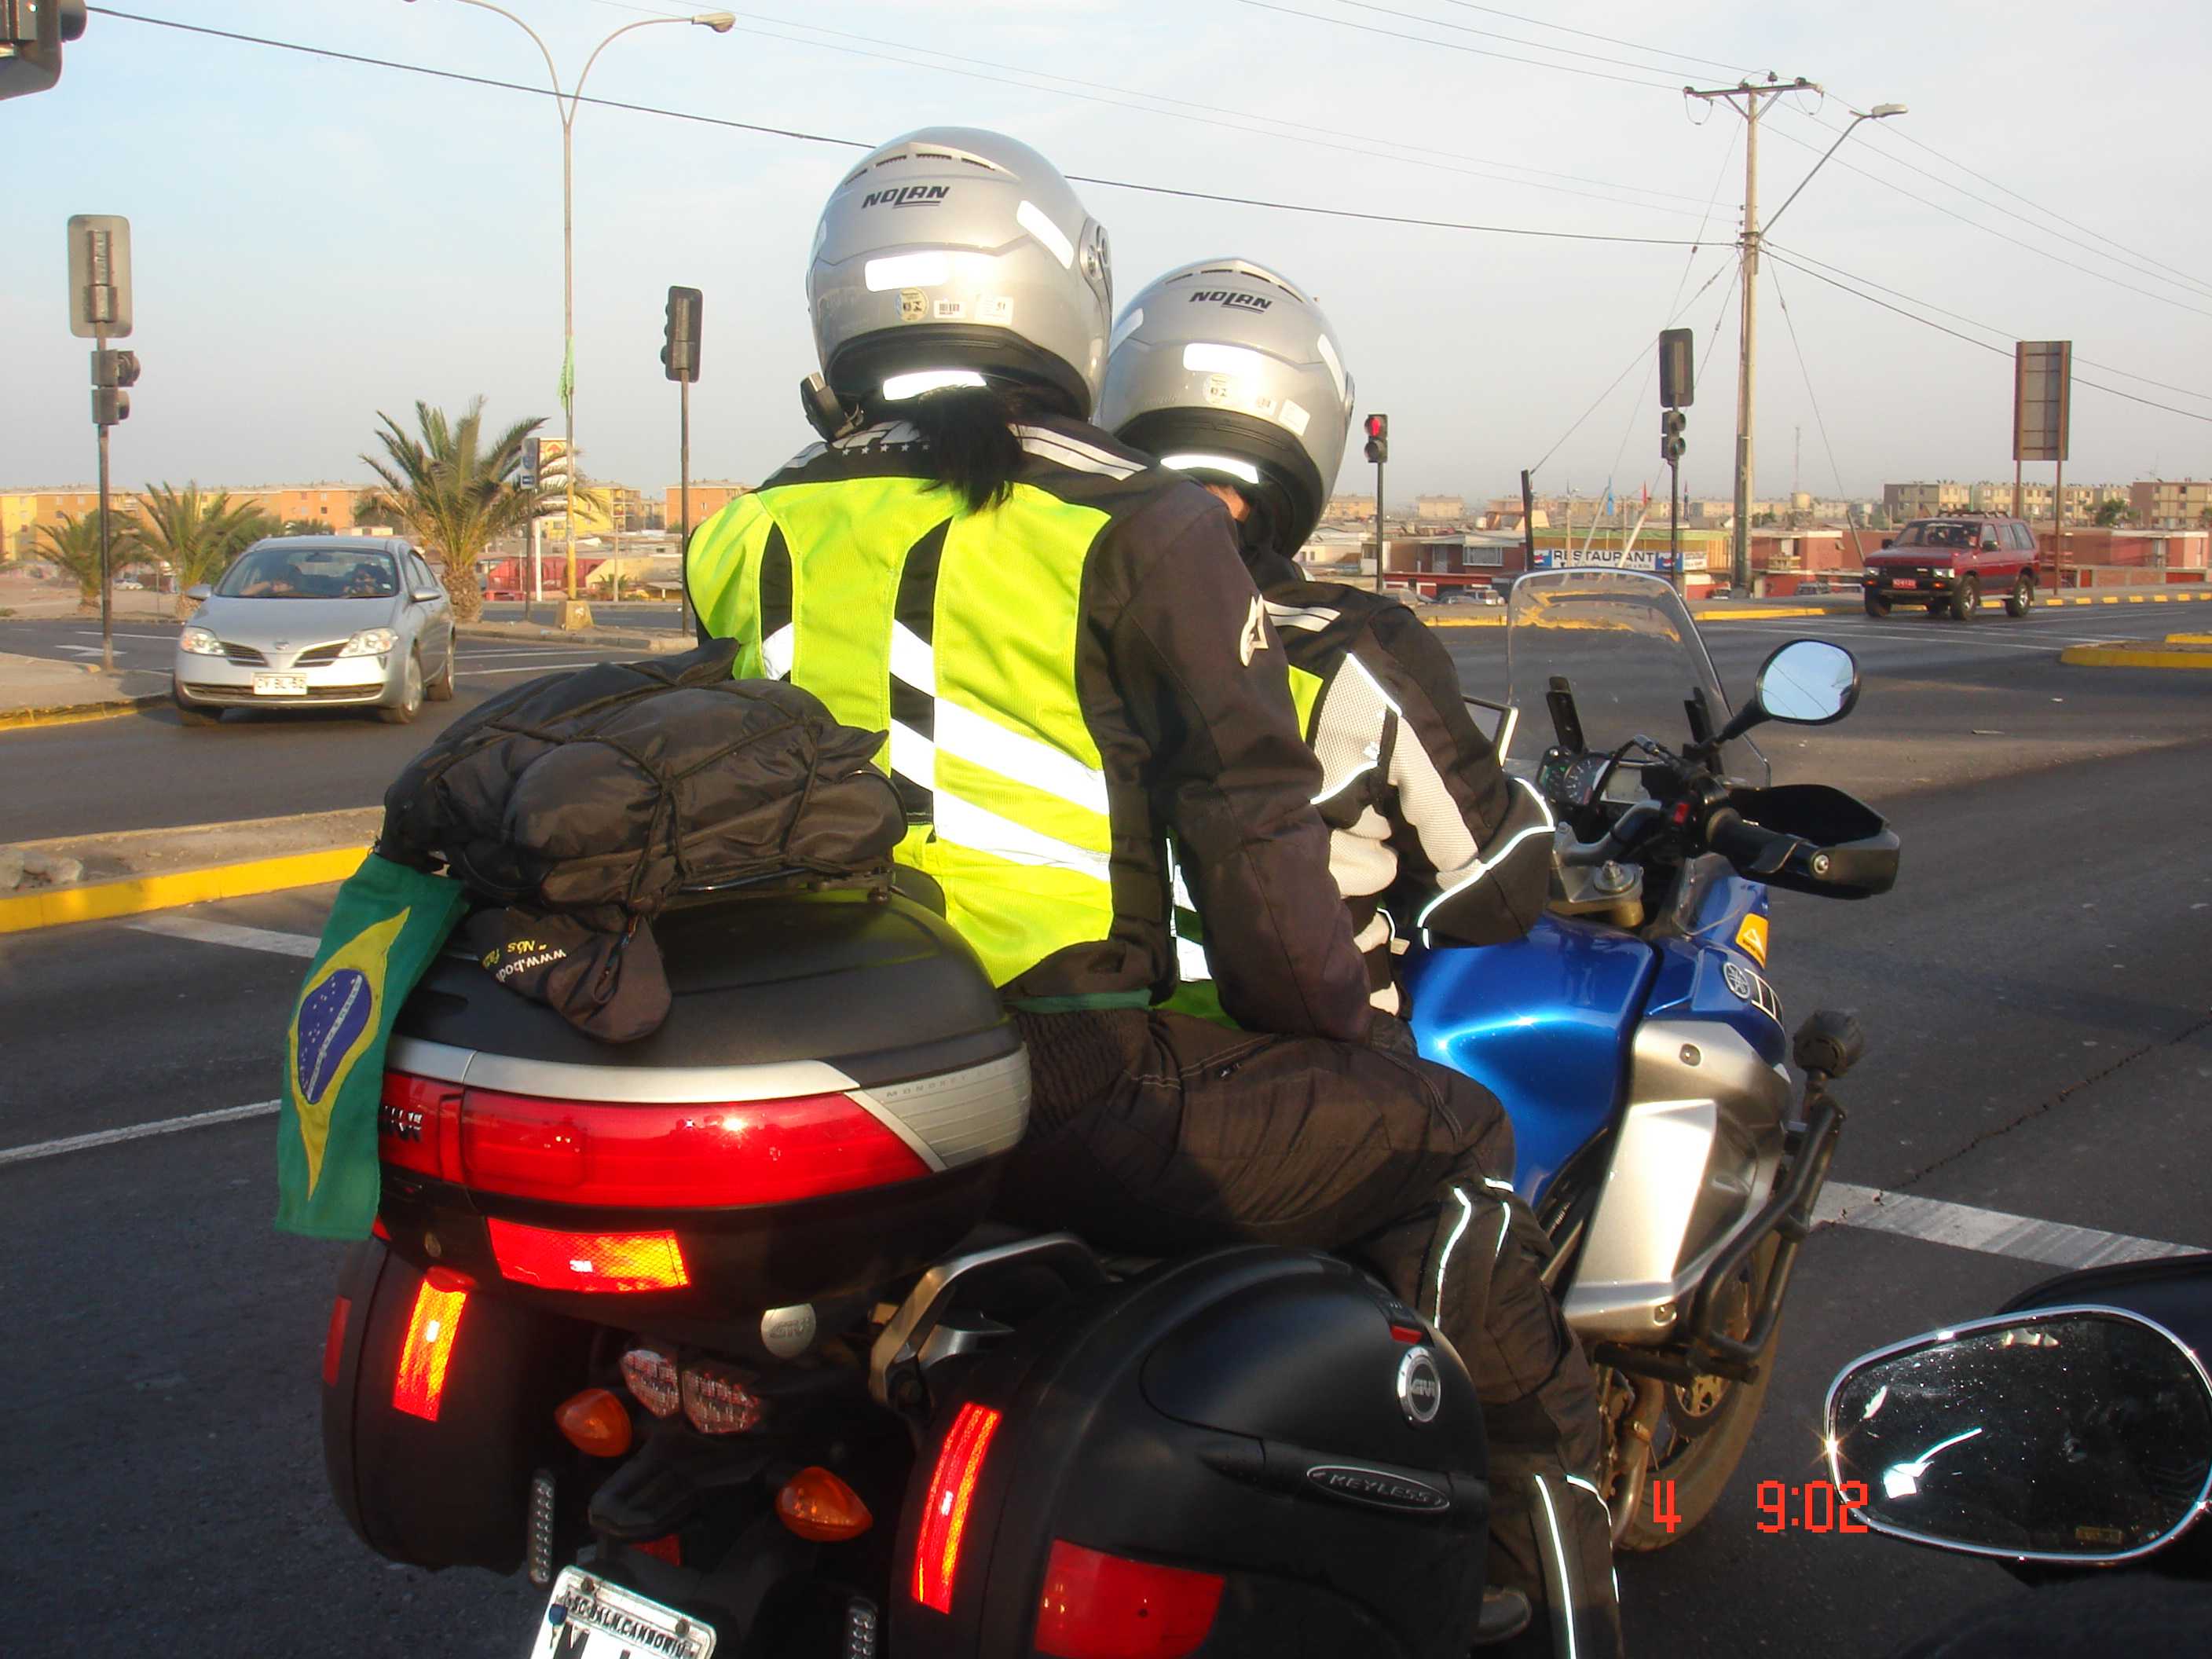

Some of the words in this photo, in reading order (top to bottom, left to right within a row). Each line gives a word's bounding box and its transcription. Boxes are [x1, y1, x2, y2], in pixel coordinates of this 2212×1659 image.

[862, 185, 950, 209] NOLAN
[1189, 291, 1273, 313] NOLAN
[1330, 1474, 1430, 1503] KEYLESS
